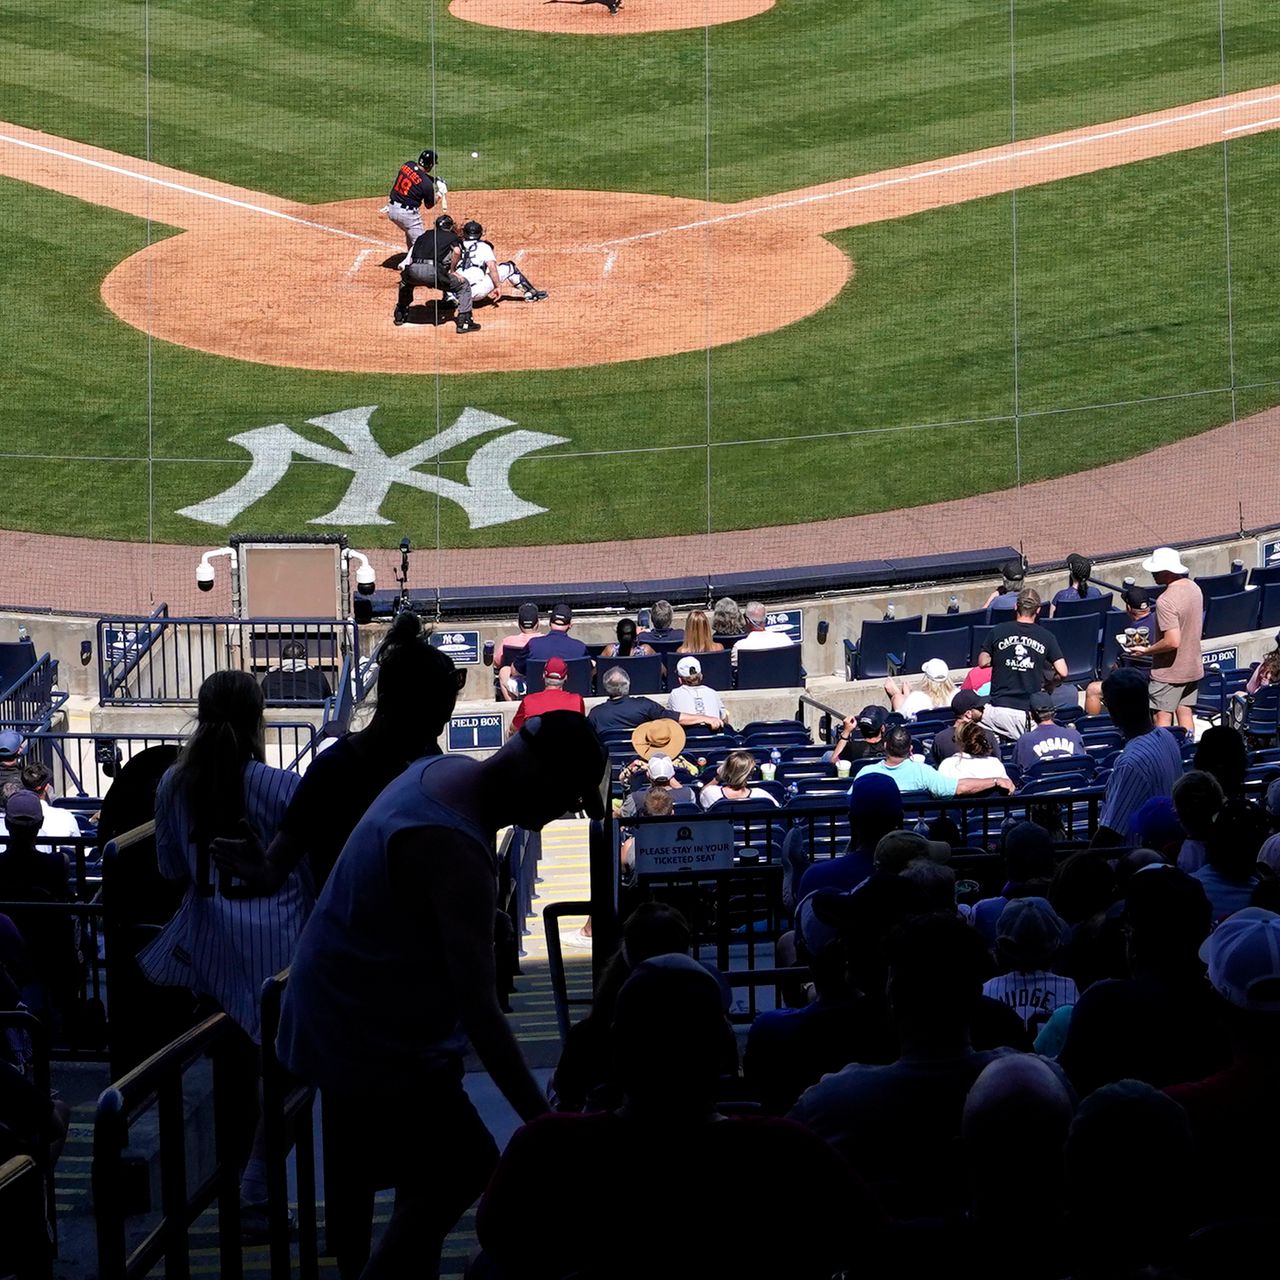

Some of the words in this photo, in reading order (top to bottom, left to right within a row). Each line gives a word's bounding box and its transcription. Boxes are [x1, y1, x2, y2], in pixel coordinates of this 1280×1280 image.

[1219, 650, 1235, 661] BOX
[451, 718, 478, 728] FIELD
[480, 716, 500, 726] BOX
[1032, 736, 1075, 757] POSADA
[640, 846, 670, 856] PLEASE
[672, 845, 692, 855] STAY
[694, 845, 703, 853] IN
[704, 843, 730, 853] YOUR
[653, 855, 694, 865] TICKETED
[696, 854, 715, 863] SEAT
